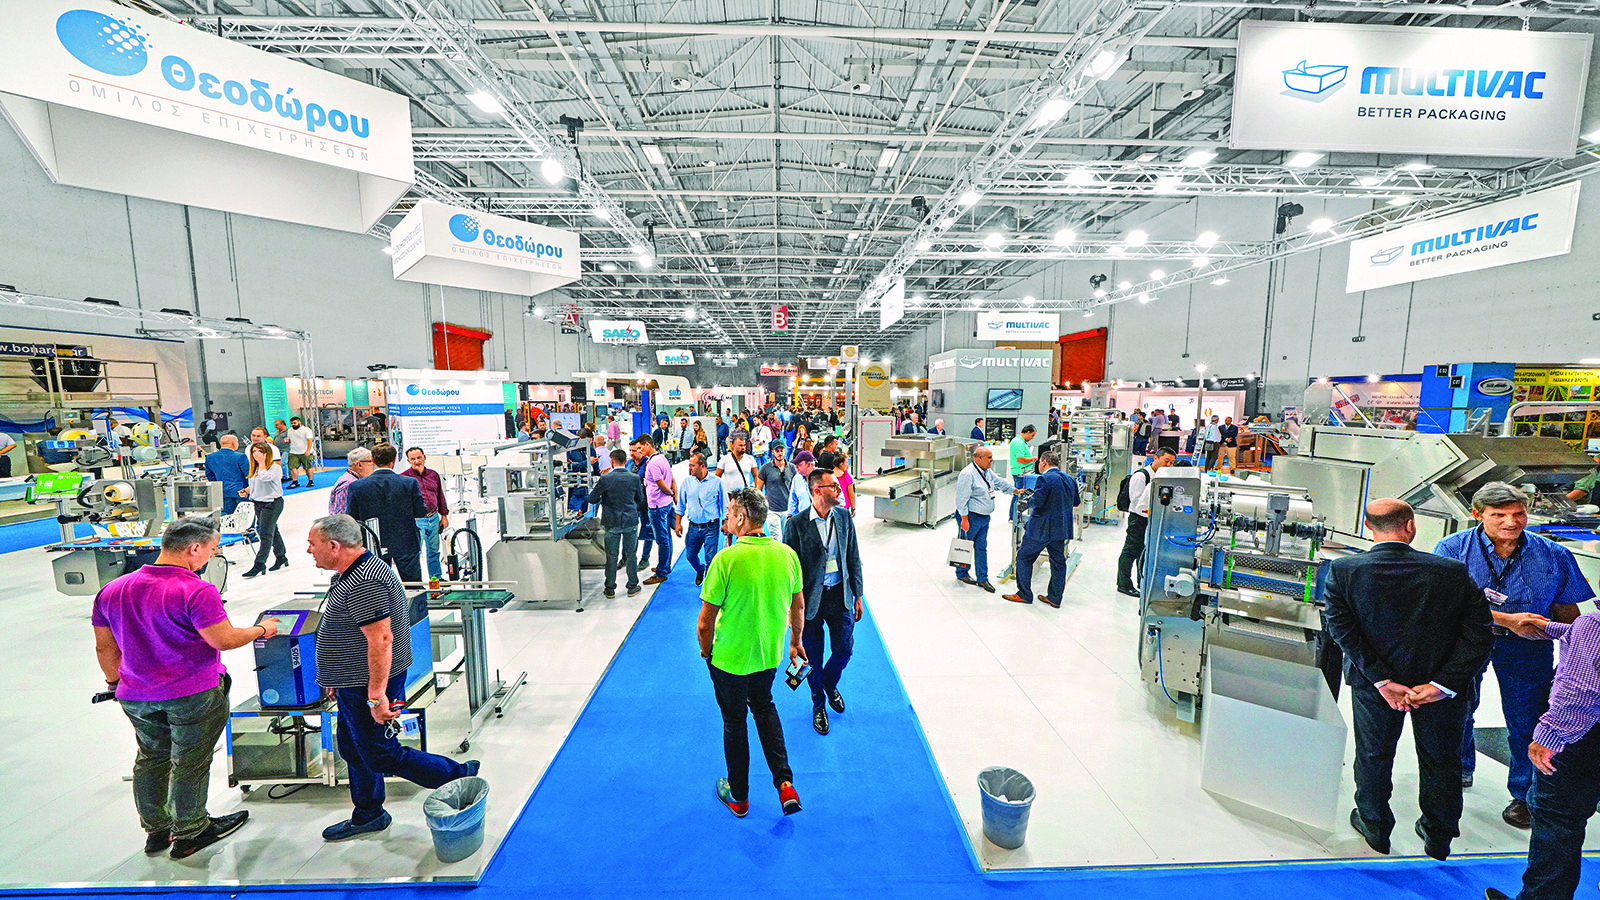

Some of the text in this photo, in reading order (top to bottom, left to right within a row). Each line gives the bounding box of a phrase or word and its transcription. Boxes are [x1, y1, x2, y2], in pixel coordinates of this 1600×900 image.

[161, 55, 370, 138] Θεοδώρου
[1360, 66, 1546, 99] MULTIVAC
[69, 79, 370, 162] ΟΜΙΛΟΣ ΕΠΙΧΕΙΡΗΣΕΩΝ
[1357, 106, 1507, 121] BETTER PACKAGING
[483, 229, 563, 258] Θεοδώρου
[1411, 213, 1539, 256] MULTIVAC
[1409, 240, 1508, 267] BETTER PACKAGING
[1006, 321, 1050, 329] MULTIVAC
[982, 357, 1050, 368] MULTIVAC
[421, 387, 460, 397] Θεοδώρου
